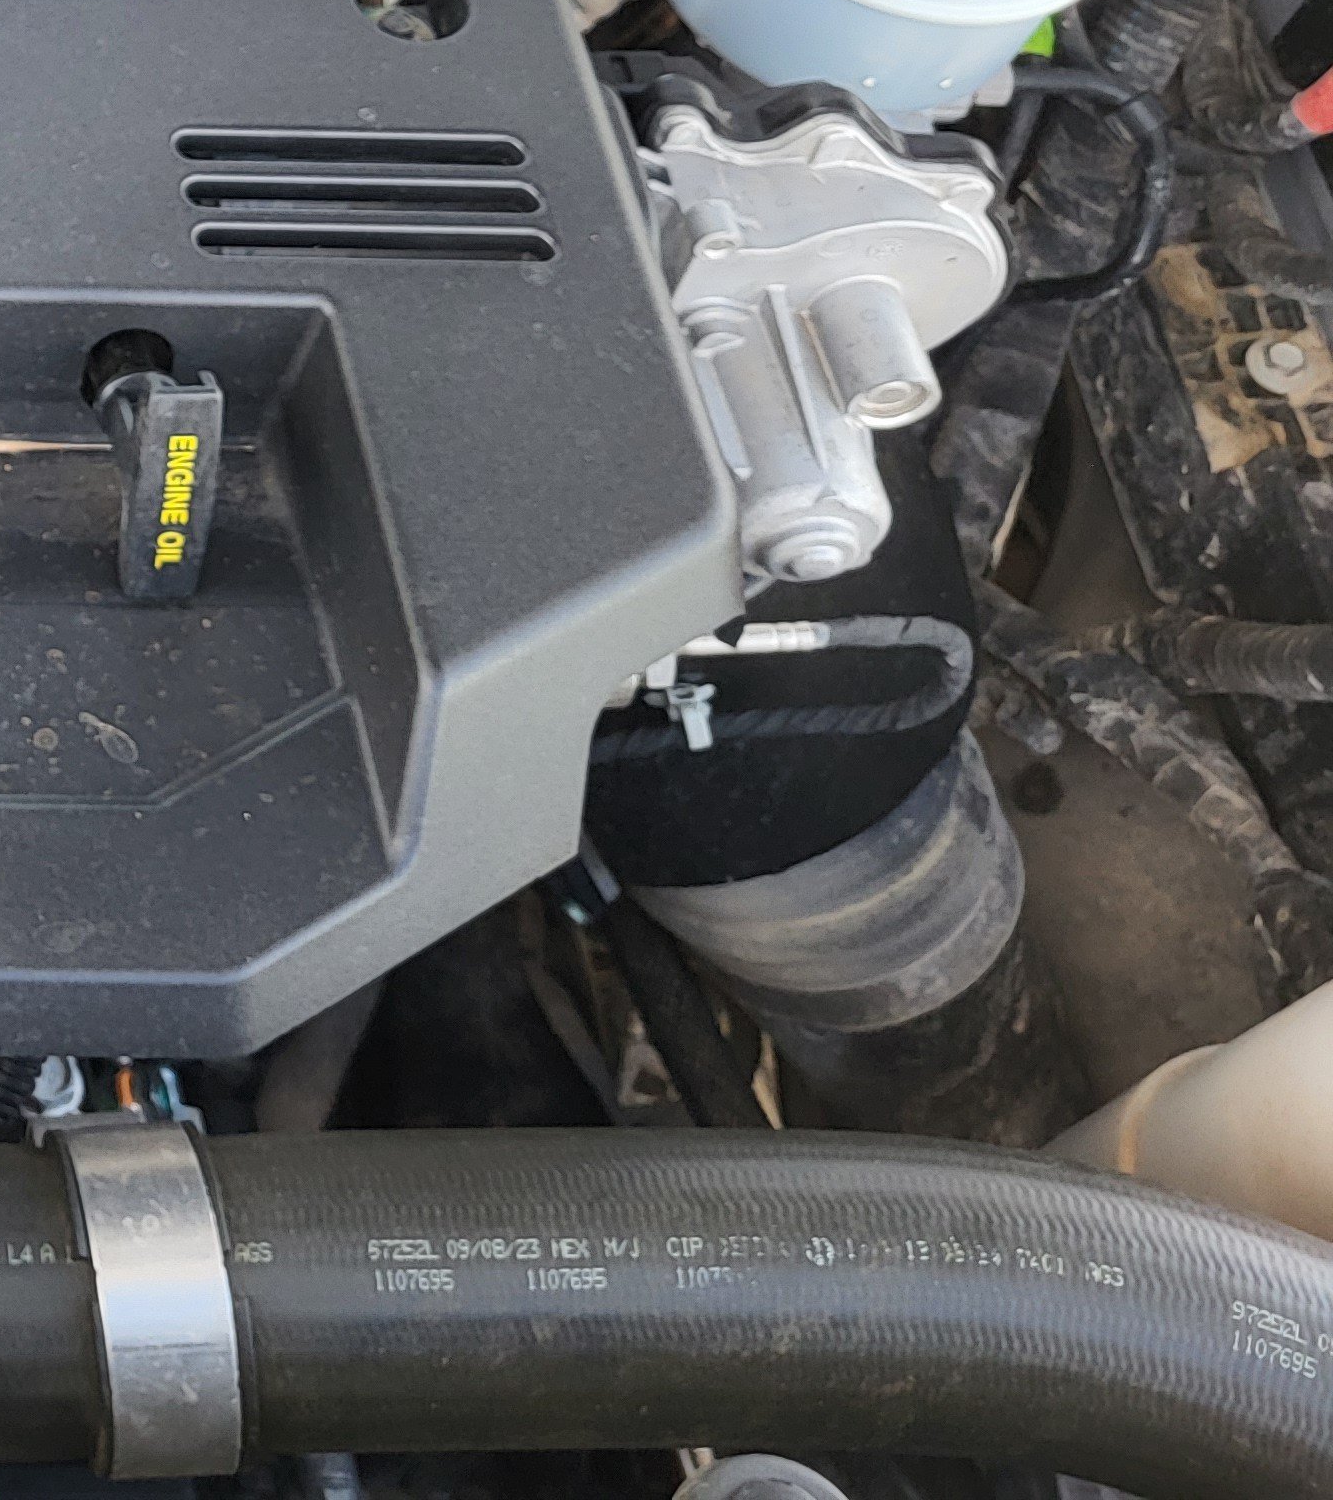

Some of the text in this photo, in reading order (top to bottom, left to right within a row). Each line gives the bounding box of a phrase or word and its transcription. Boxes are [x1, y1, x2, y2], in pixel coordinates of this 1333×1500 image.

[153, 434, 200, 571] ENGINE OIL
[665, 1235, 704, 1259] CIP
[374, 1267, 456, 1292] 1107695
[527, 1266, 608, 1291] 1107695
[1232, 1328, 1319, 1380] 1107695
